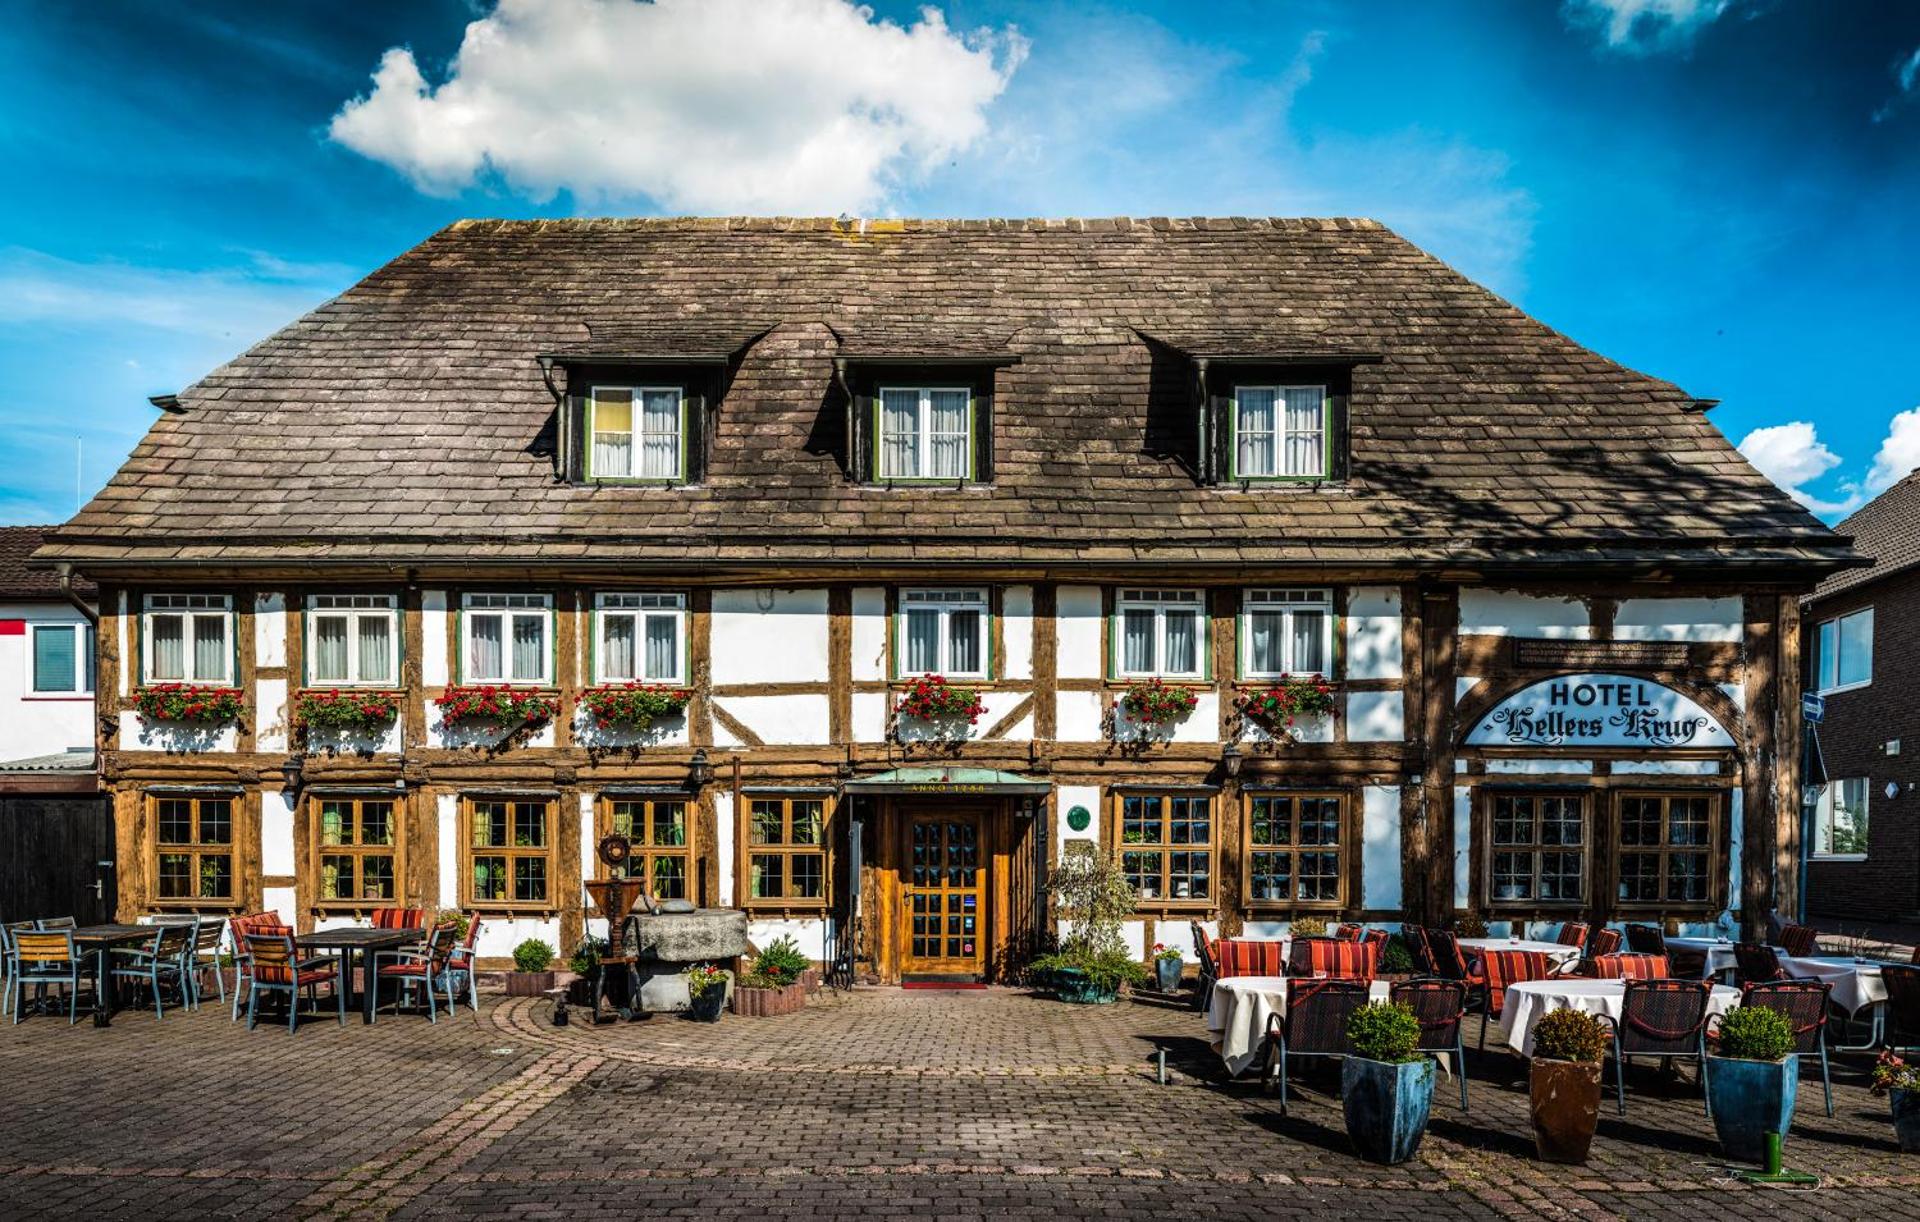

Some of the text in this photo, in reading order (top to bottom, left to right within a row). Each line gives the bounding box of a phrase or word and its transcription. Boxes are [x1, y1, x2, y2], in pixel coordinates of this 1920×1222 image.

[1551, 684, 1650, 706] HOTEL
[1492, 707, 1708, 745] Hellers Krug
[912, 784, 946, 792] ANNO
